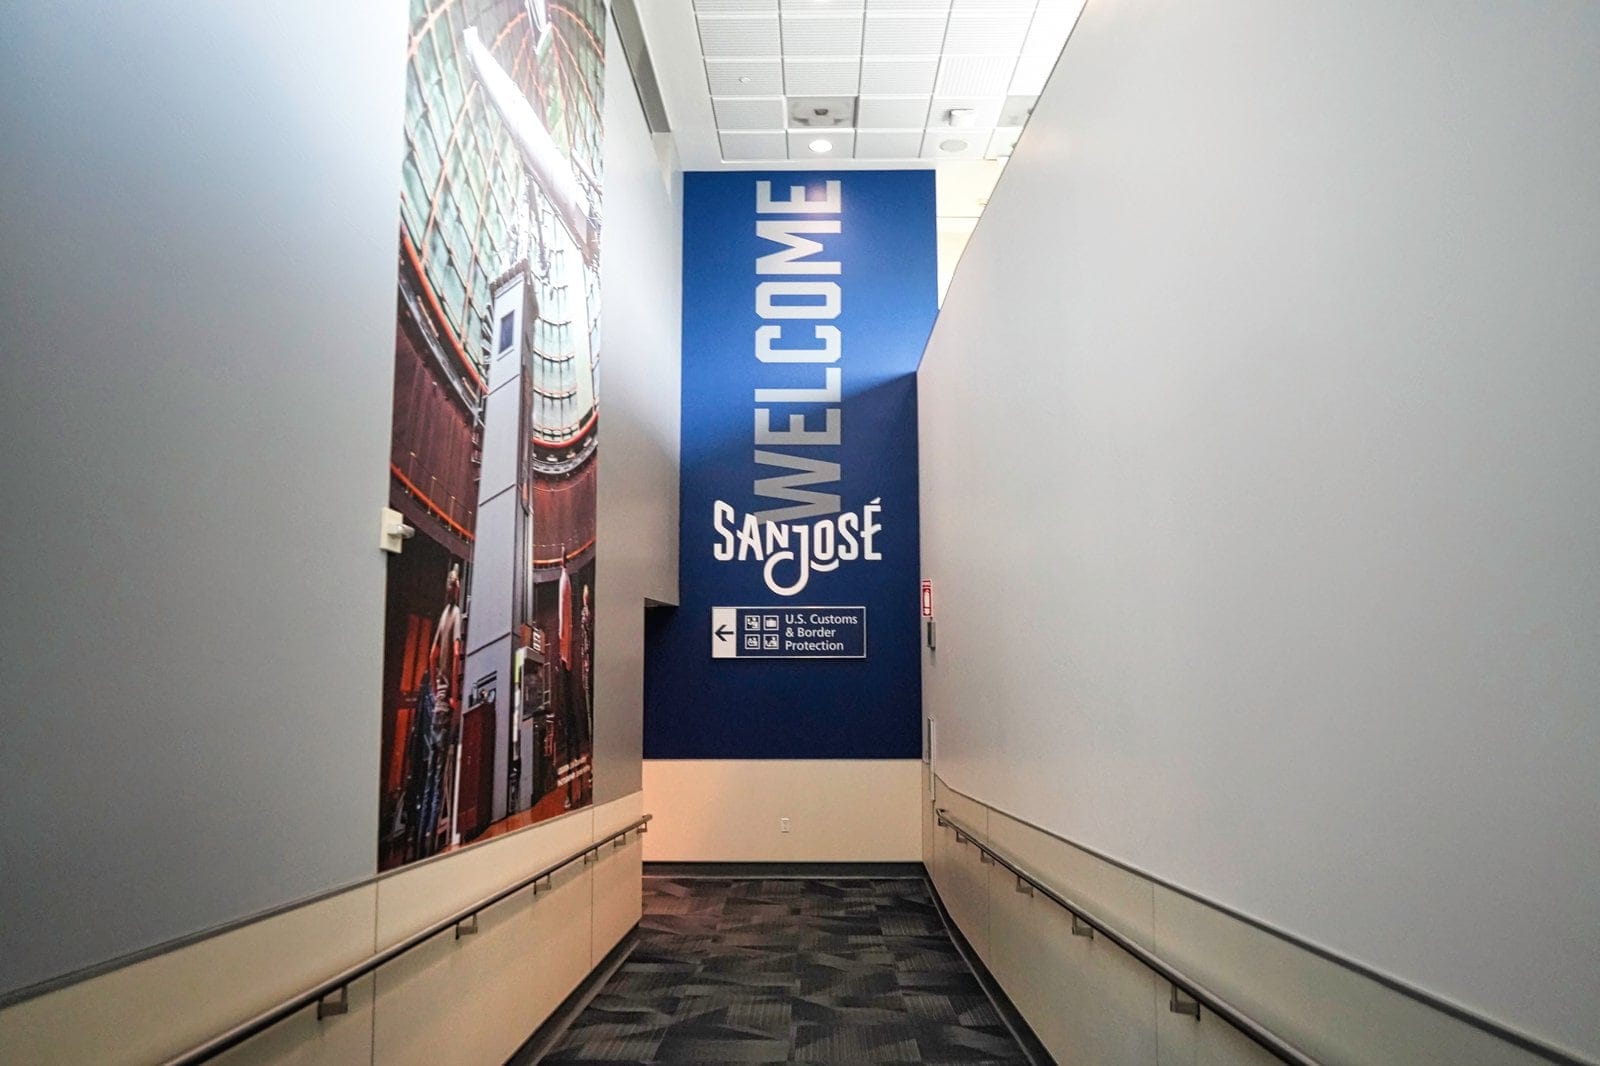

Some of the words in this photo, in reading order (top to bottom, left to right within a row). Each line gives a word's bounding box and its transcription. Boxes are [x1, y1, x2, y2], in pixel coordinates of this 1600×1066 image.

[755, 180, 842, 525] WELCOME
[785, 613, 807, 625] U.S.
[809, 613, 858, 625] Customs
[785, 627, 794, 638] &
[797, 627, 837, 638] Border
[785, 640, 844, 651] Protection
